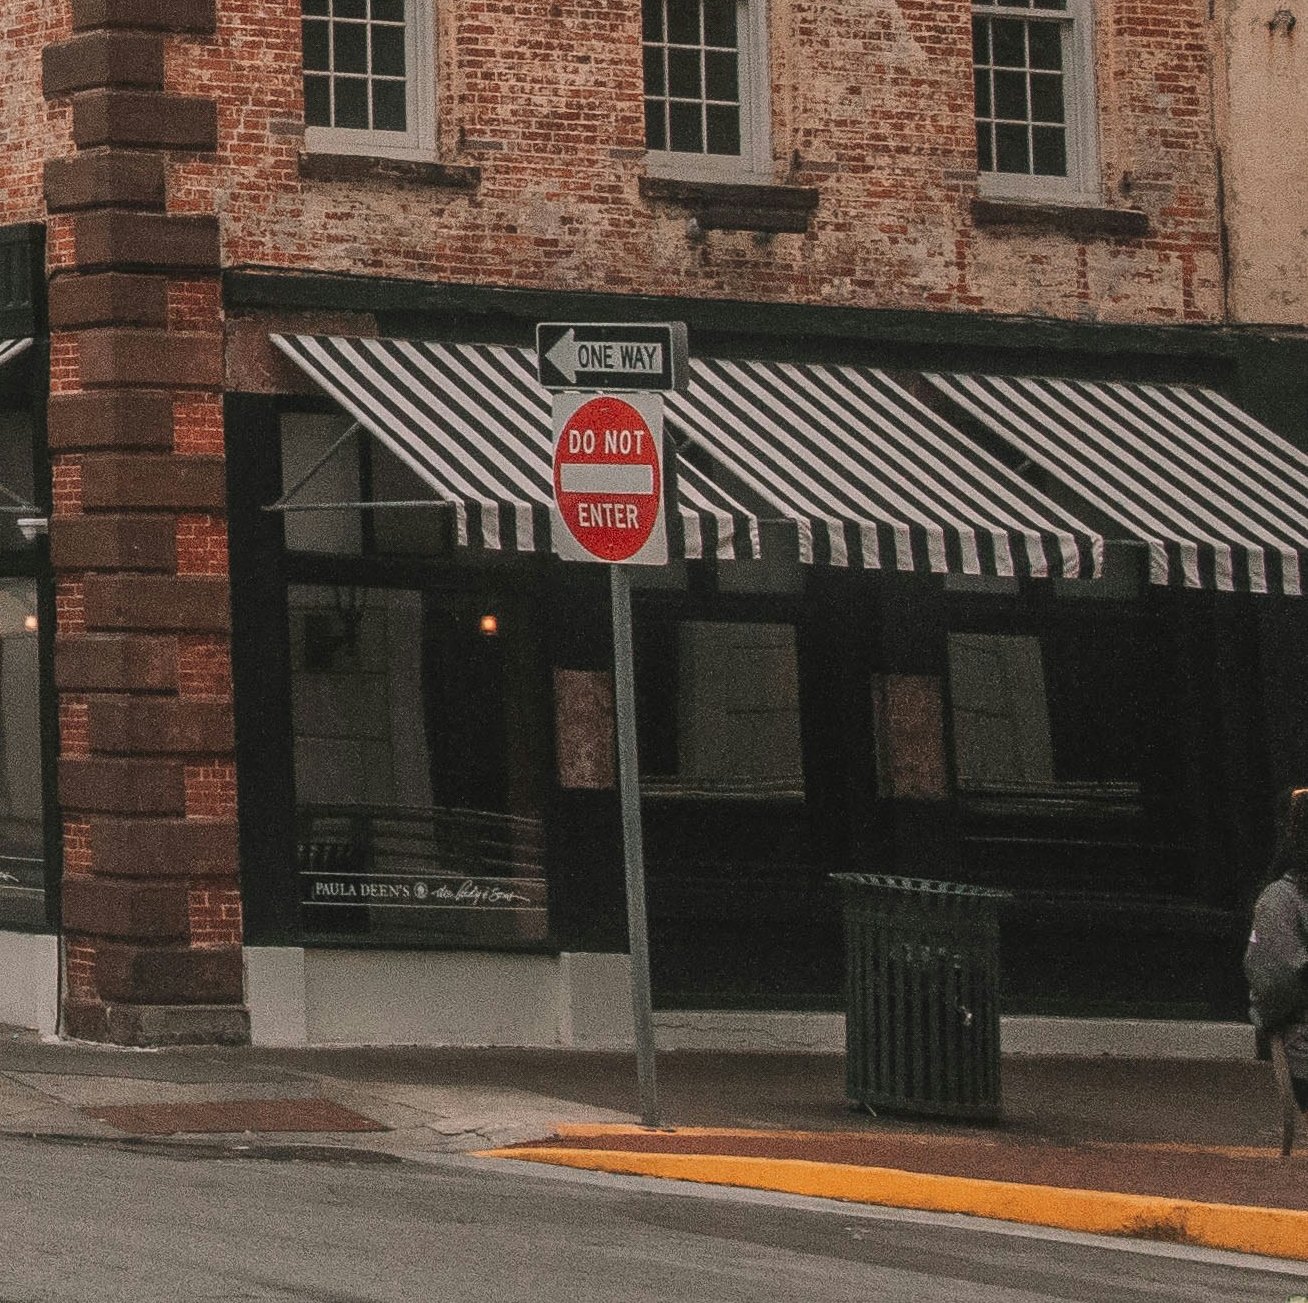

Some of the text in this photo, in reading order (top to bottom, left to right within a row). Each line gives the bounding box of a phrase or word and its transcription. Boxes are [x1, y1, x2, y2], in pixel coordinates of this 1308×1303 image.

[577, 344, 657, 372] ONE WAY
[568, 429, 645, 455] DO NOT
[578, 502, 640, 530] ENTER
[315, 881, 357, 897] PAULA
[360, 883, 411, 898] DEEN'S
